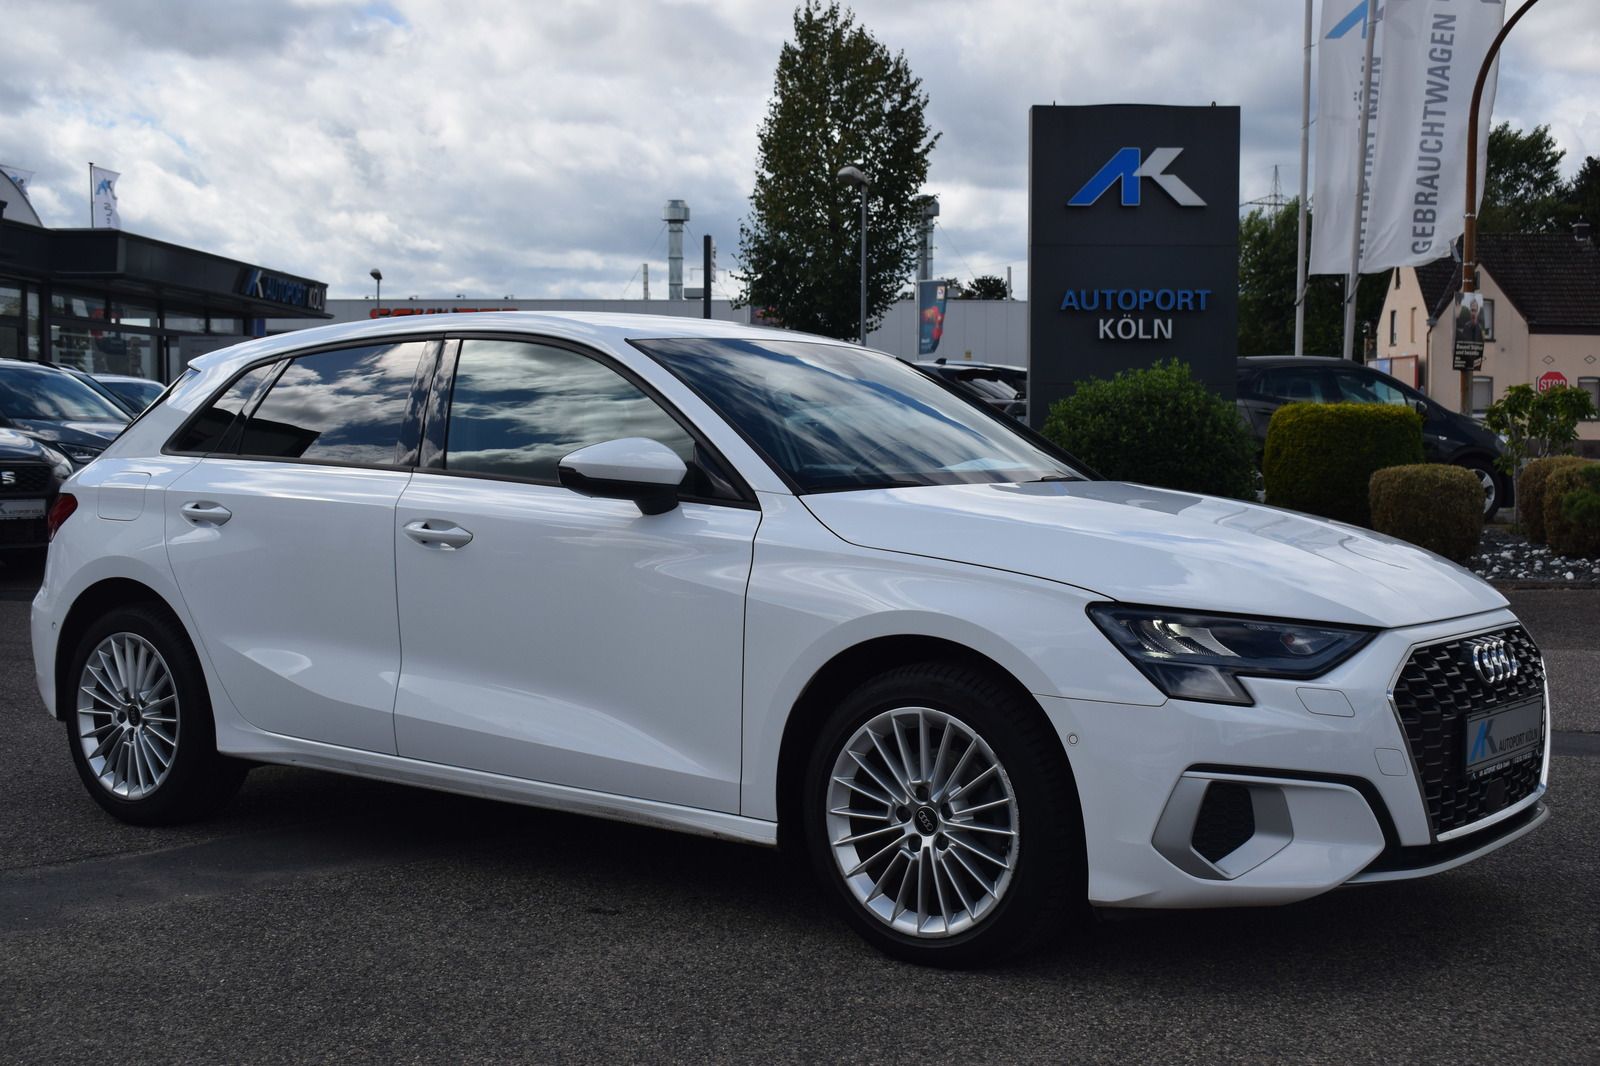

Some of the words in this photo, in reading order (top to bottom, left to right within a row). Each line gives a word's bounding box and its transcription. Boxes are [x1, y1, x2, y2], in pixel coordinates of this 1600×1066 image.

[1411, 13, 1457, 255] GEBRAUCHTWAGEN
[1066, 147, 1208, 206] AK
[1060, 289, 1212, 311] AUTOPORT
[1098, 313, 1173, 339] KÖLN
[1499, 733, 1525, 751] AUTOPORT
